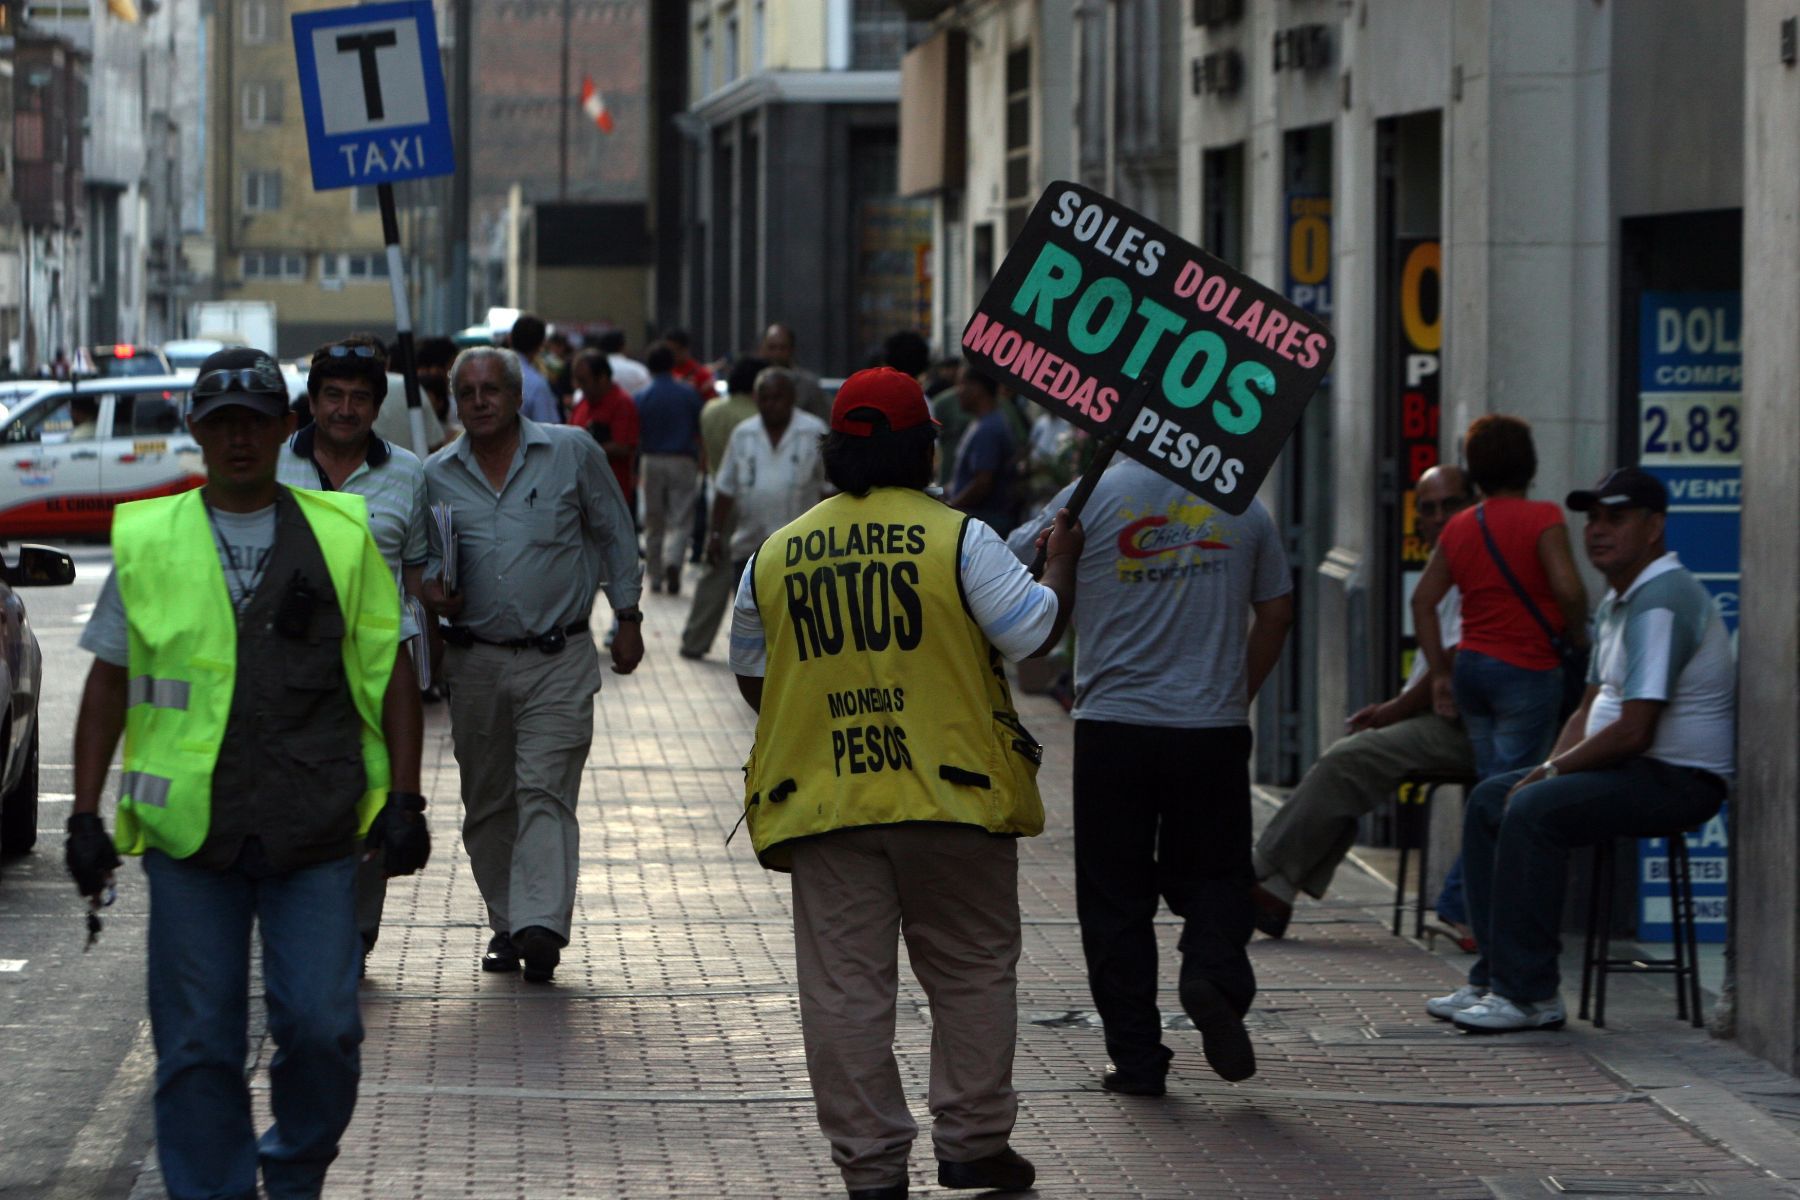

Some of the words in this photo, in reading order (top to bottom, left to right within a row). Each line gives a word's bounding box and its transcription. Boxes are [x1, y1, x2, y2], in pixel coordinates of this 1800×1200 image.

[336, 28, 397, 121] T
[338, 134, 426, 178] TAXI
[1050, 190, 1167, 278] SOLES
[1173, 258, 1328, 370] DOLARES
[1009, 240, 1278, 436] ROTOS
[1657, 307, 1742, 354] DOL
[961, 311, 1120, 424] MONEDAS
[1126, 405, 1246, 495] PESOS
[1645, 406, 1739, 453] 2.83
[1667, 478, 1742, 499] VENT
[785, 522, 926, 568] DOLARES
[784, 559, 923, 661] ROTOS
[831, 725, 913, 777] PESOS
